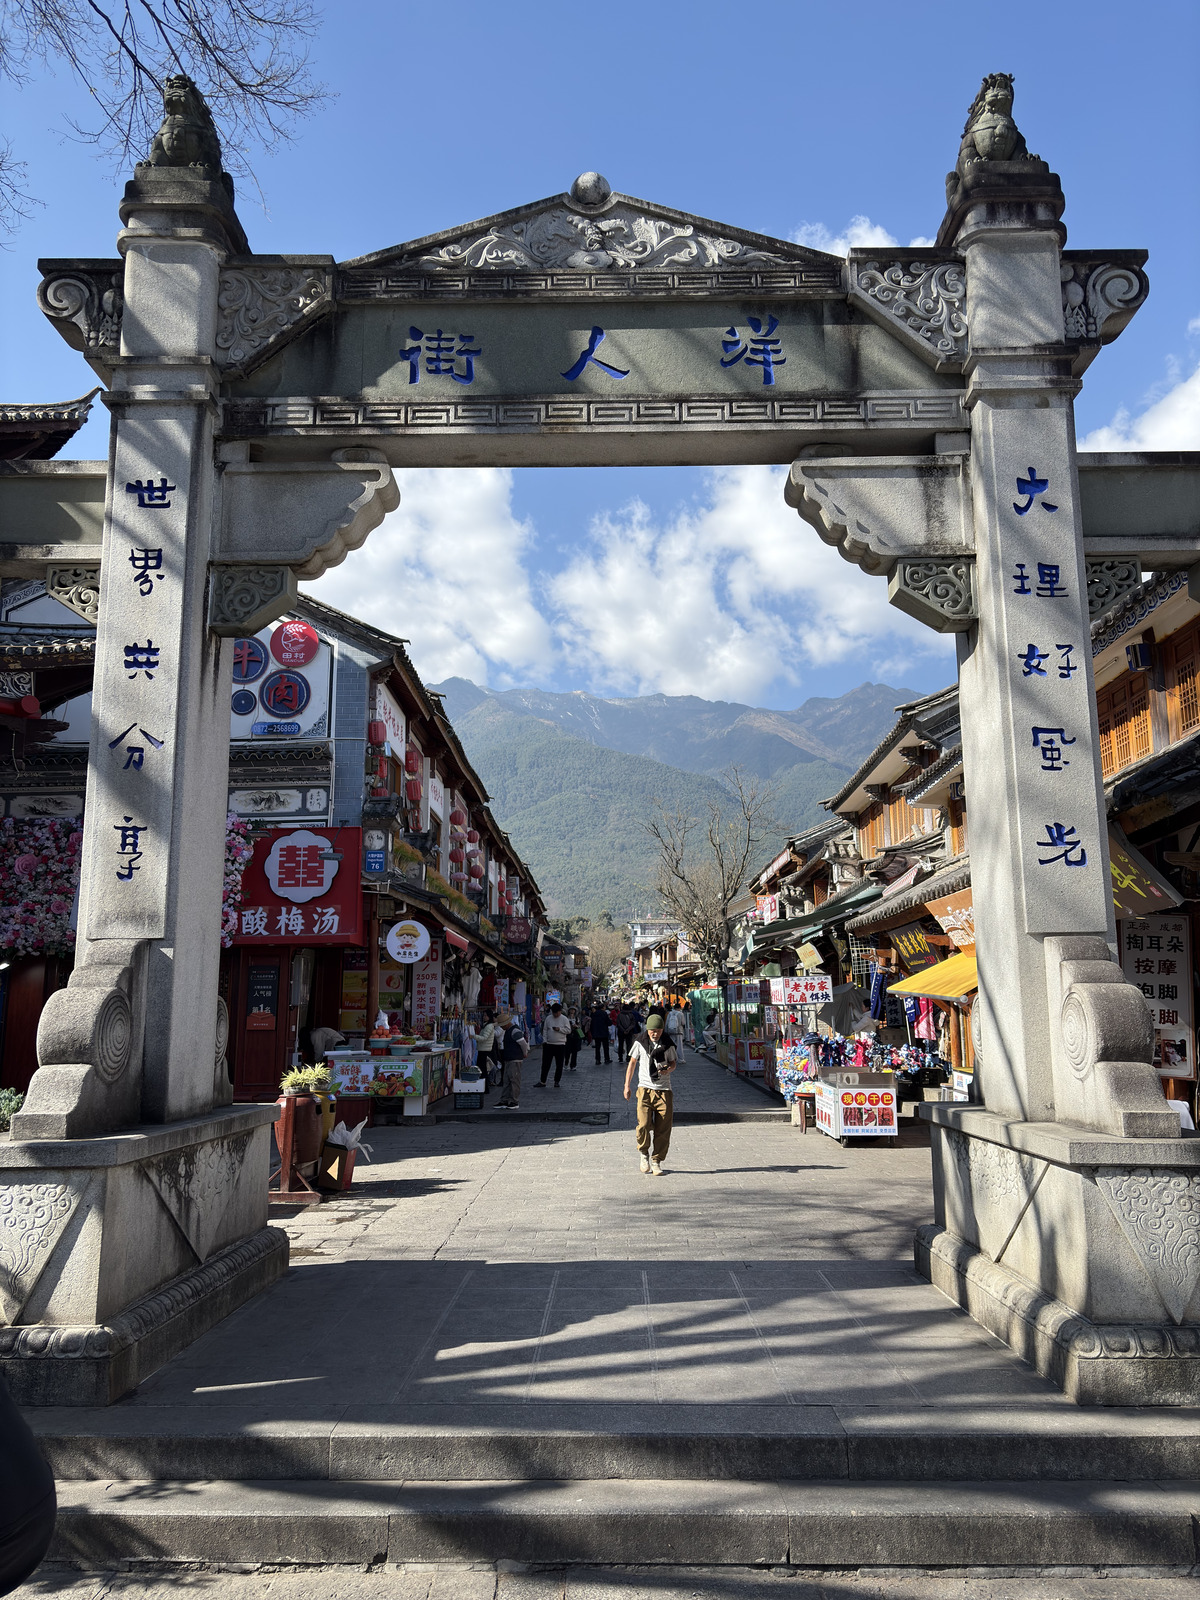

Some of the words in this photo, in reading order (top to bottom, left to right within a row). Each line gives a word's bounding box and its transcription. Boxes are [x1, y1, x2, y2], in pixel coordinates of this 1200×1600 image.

[241, 906, 340, 936] 酸梅汤
[1127, 921, 1150, 931] 正宗
[1159, 922, 1183, 932] 成都
[1126, 934, 1185, 953] 掏耳朵
[1134, 958, 1178, 975] 按摩
[790, 981, 829, 992] 老杨家
[1137, 983, 1178, 1000] 泡脚
[786, 992, 808, 1004] 乳扇
[809, 992, 831, 1002] 饵块
[251, 1003, 271, 1014] 第1名
[339, 1064, 361, 1076] 新鲜
[348, 1074, 370, 1086] 水果
[843, 1094, 892, 1105] 现烤干巴
